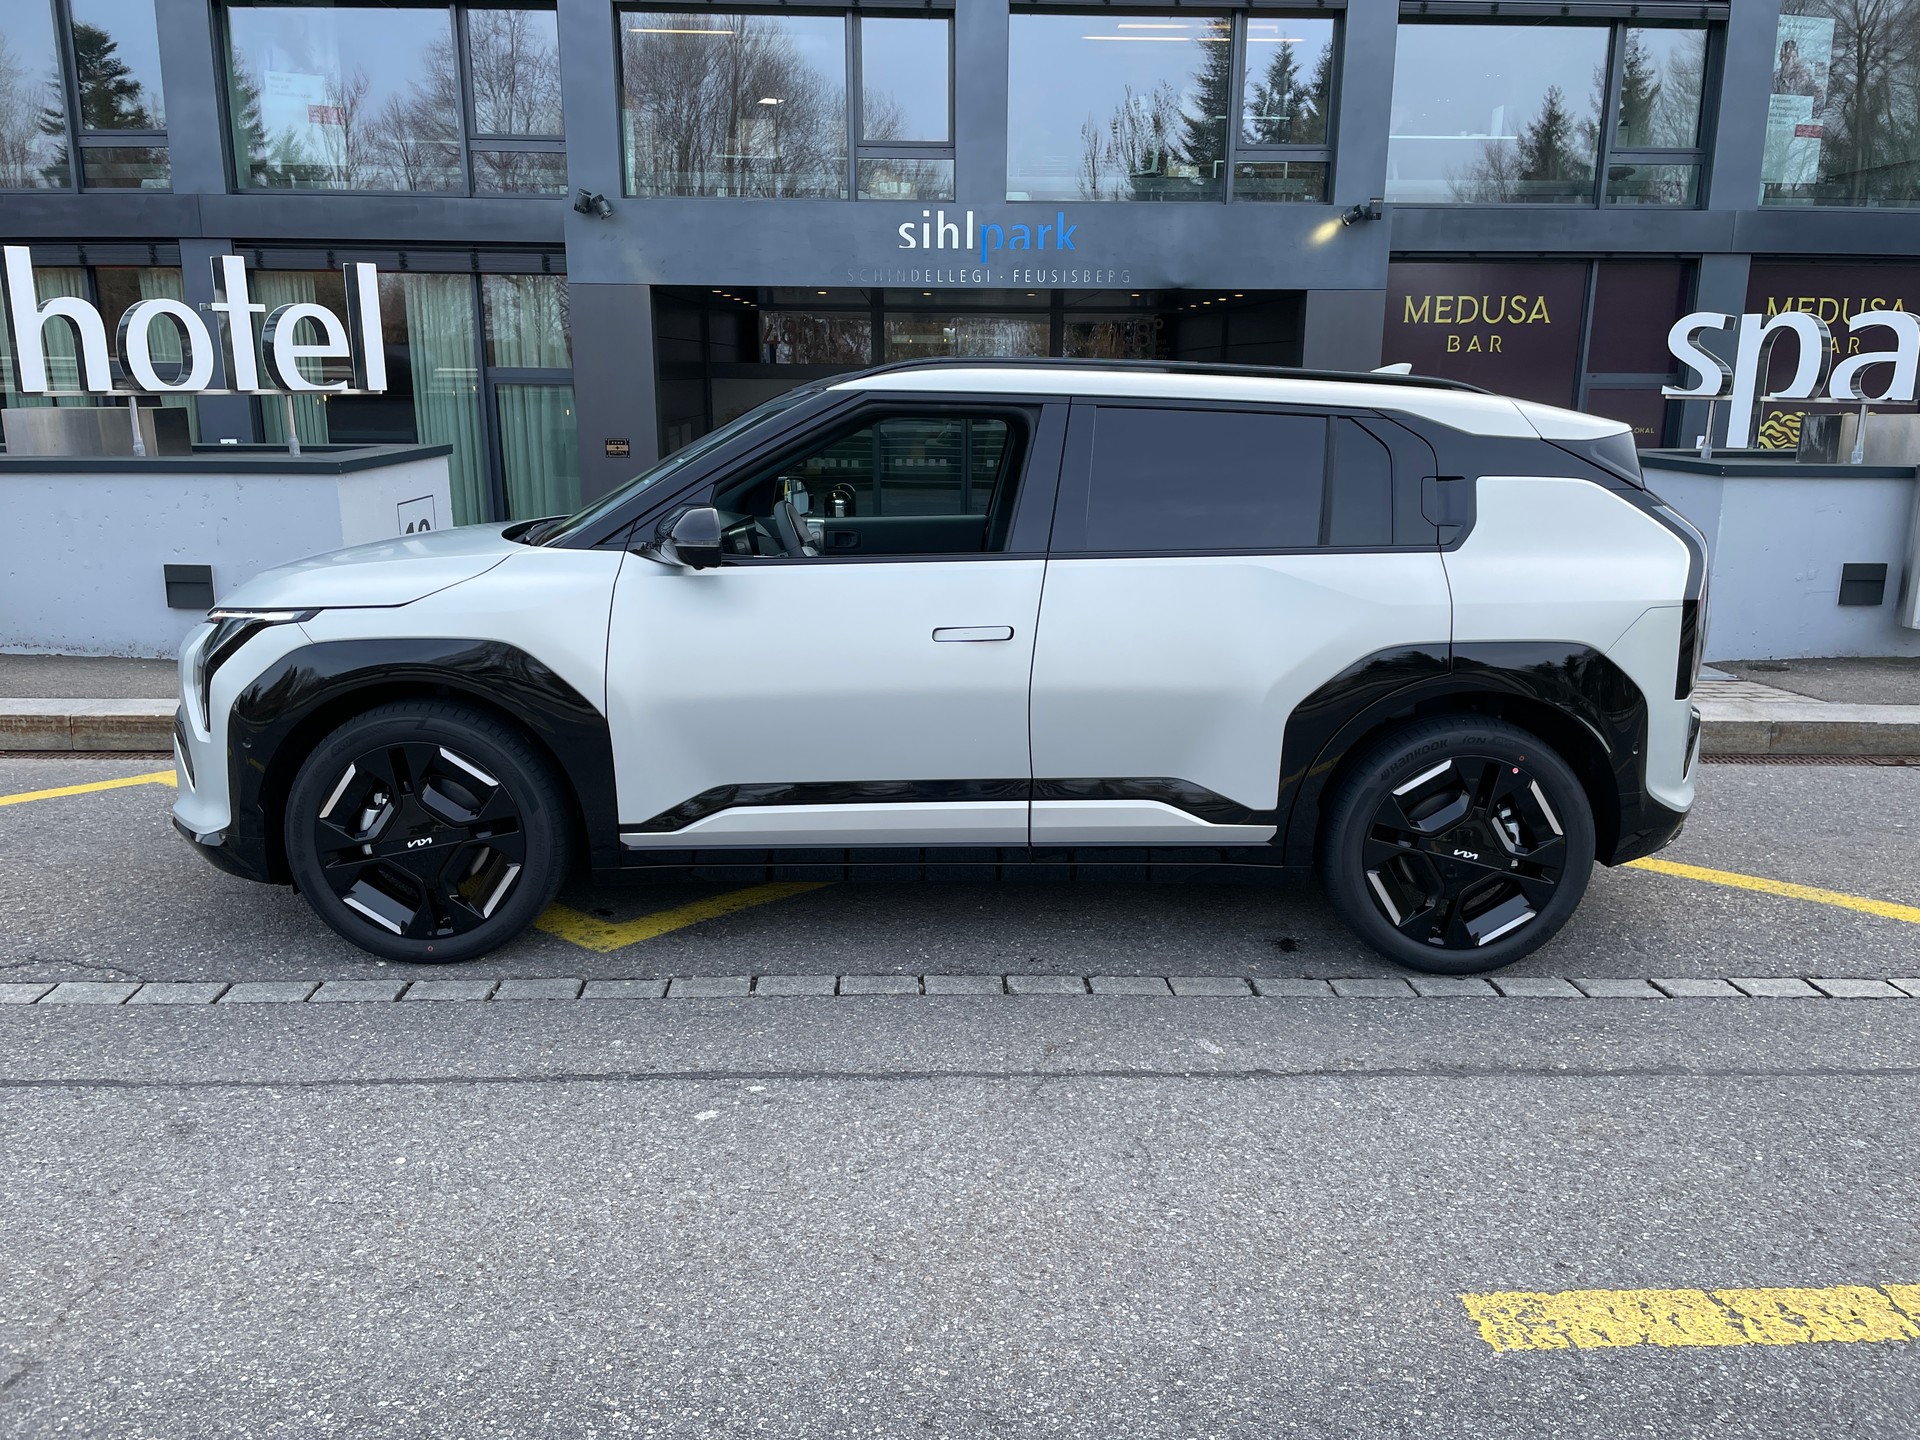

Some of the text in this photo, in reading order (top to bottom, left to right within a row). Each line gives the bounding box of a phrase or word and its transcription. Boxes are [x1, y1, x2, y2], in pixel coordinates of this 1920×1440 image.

[898, 209, 1078, 265] sihlpark
[847, 268, 1131, 284] SCHINDELLEGI FEUSISBERG
[3, 245, 388, 393] hotel
[1402, 294, 1552, 325] MEDUSA
[1446, 334, 1504, 354] BAR
[1831, 336, 1861, 354] AR
[1661, 310, 1920, 449] spa
